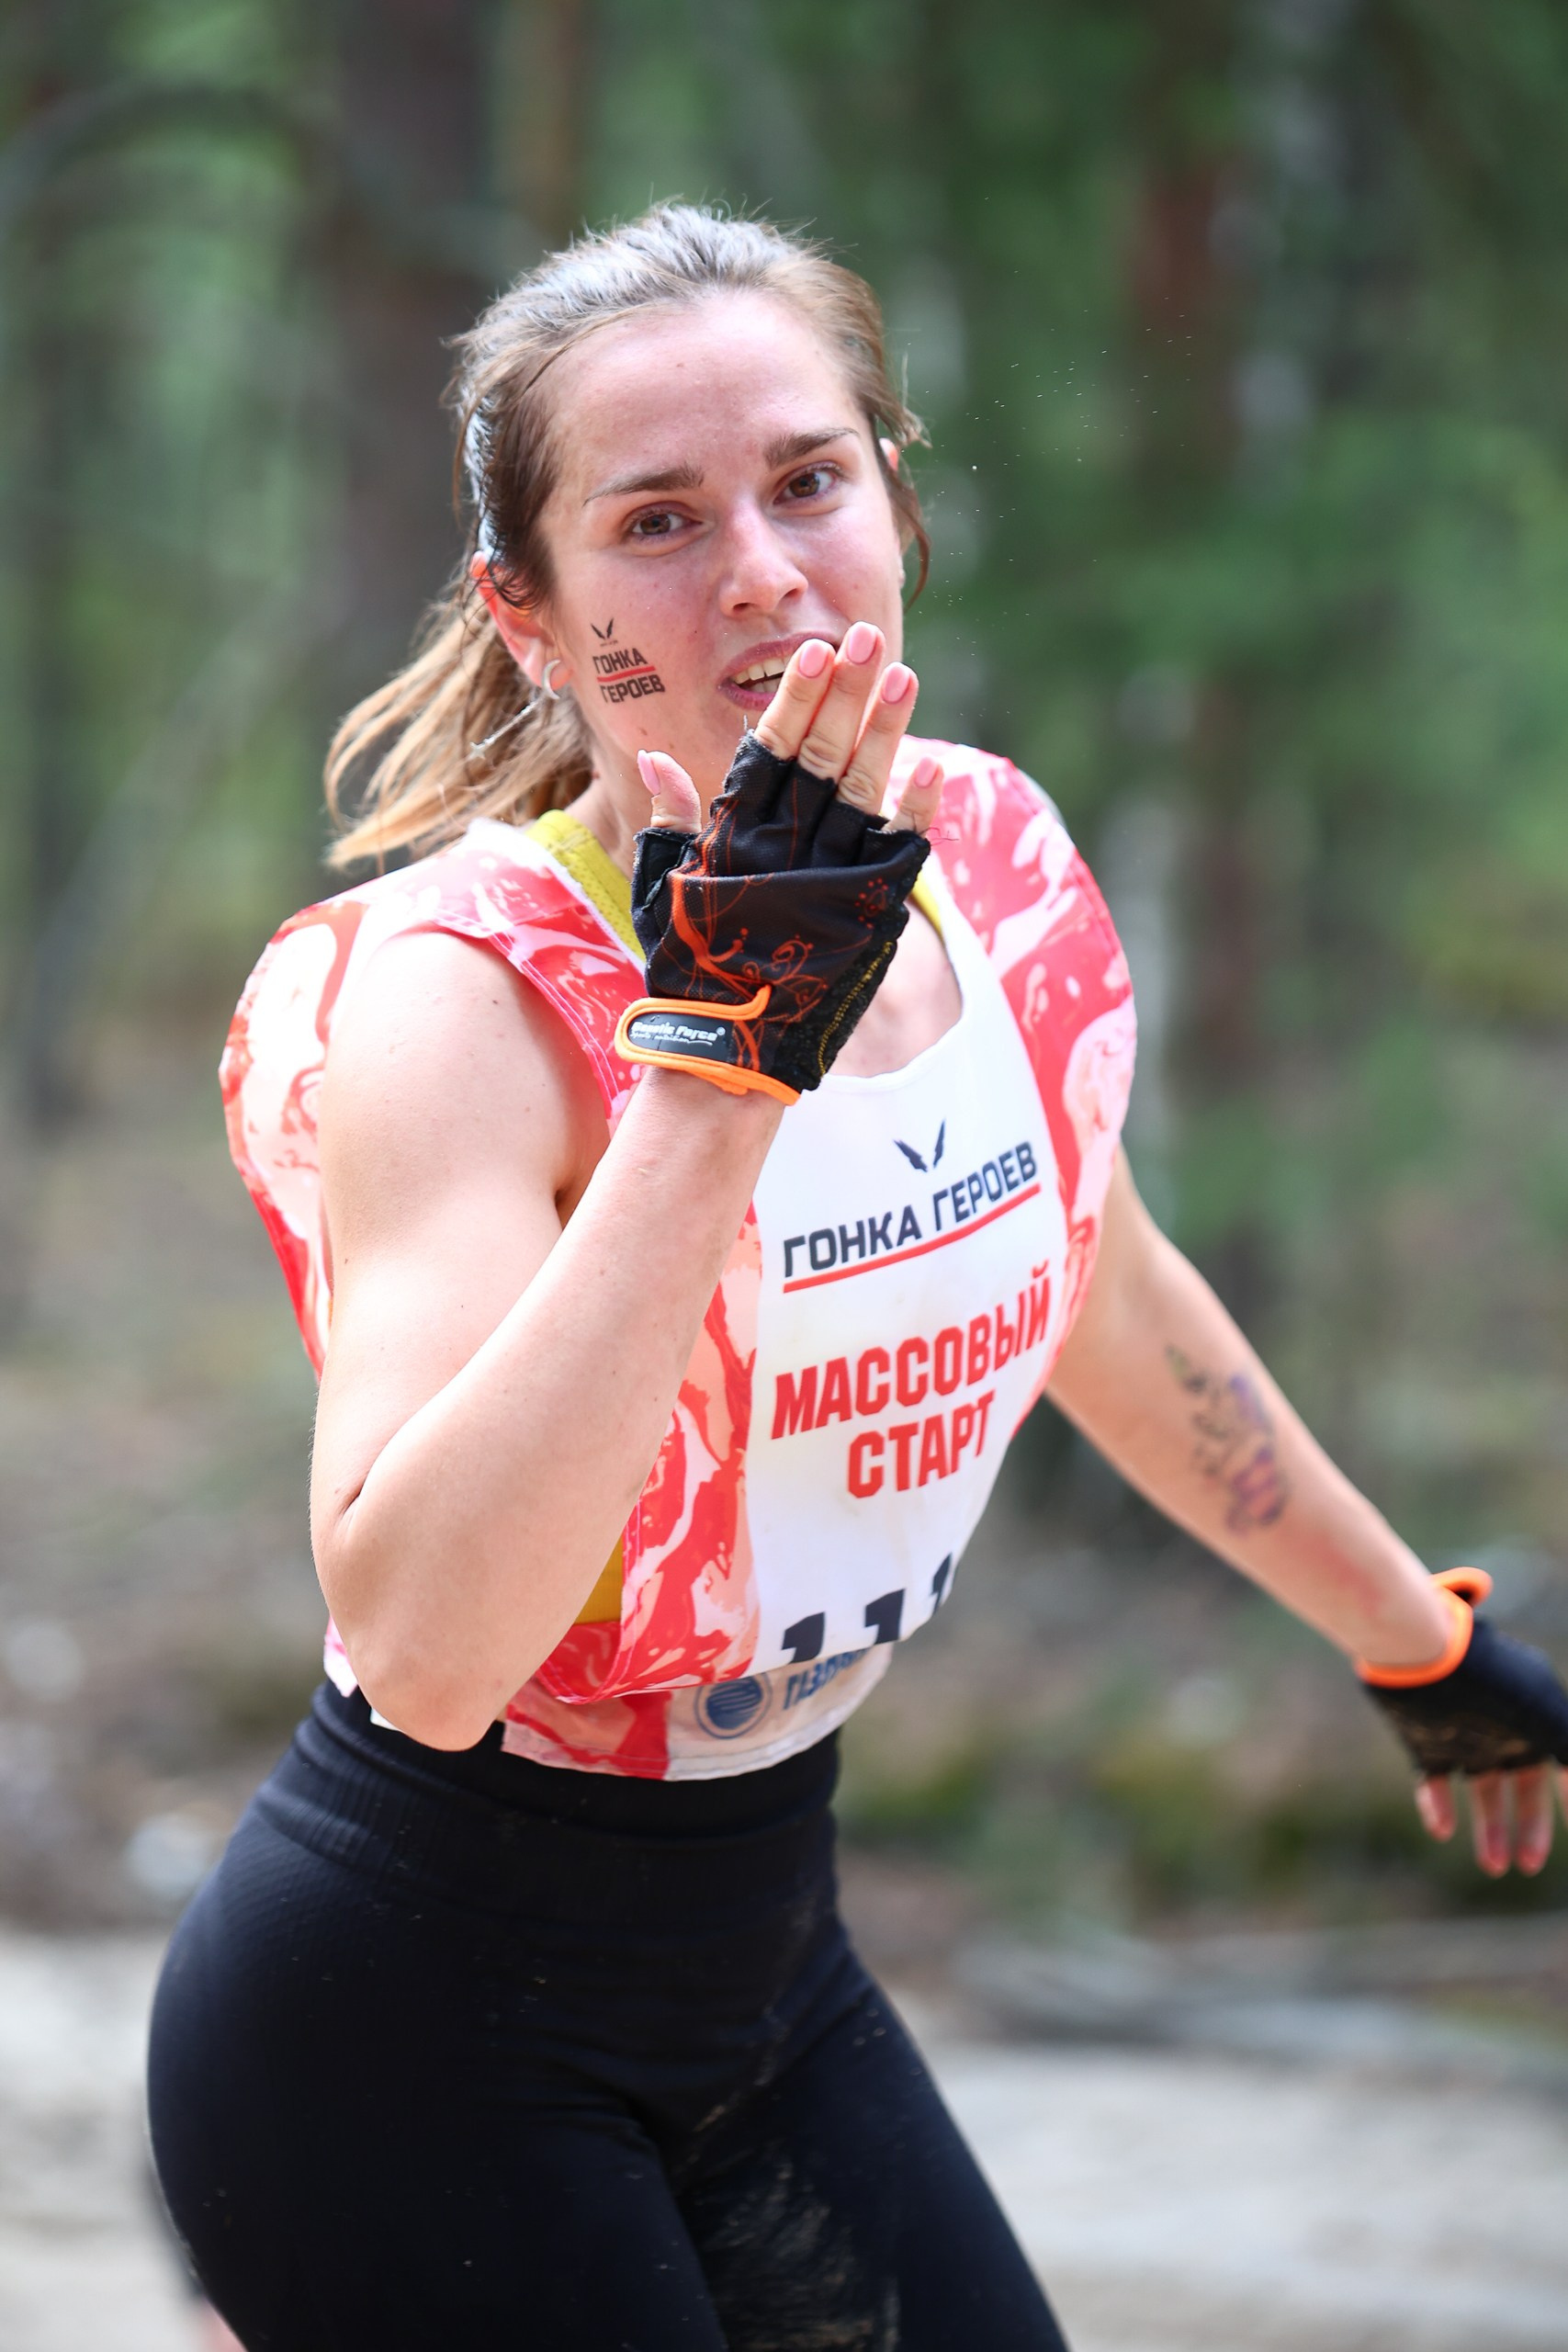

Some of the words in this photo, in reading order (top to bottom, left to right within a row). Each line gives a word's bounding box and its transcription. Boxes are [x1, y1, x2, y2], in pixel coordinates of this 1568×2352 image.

[592, 648, 648, 674] ГОНКА
[600, 674, 665, 704] ГЕРОЕВ
[784, 1204, 922, 1278] ГОНКА
[932, 1140, 1038, 1231] ГЕРОЕВ
[771, 1259, 1052, 1440] МАССОВЫЙ
[847, 1389, 996, 1498] СТАРТ
